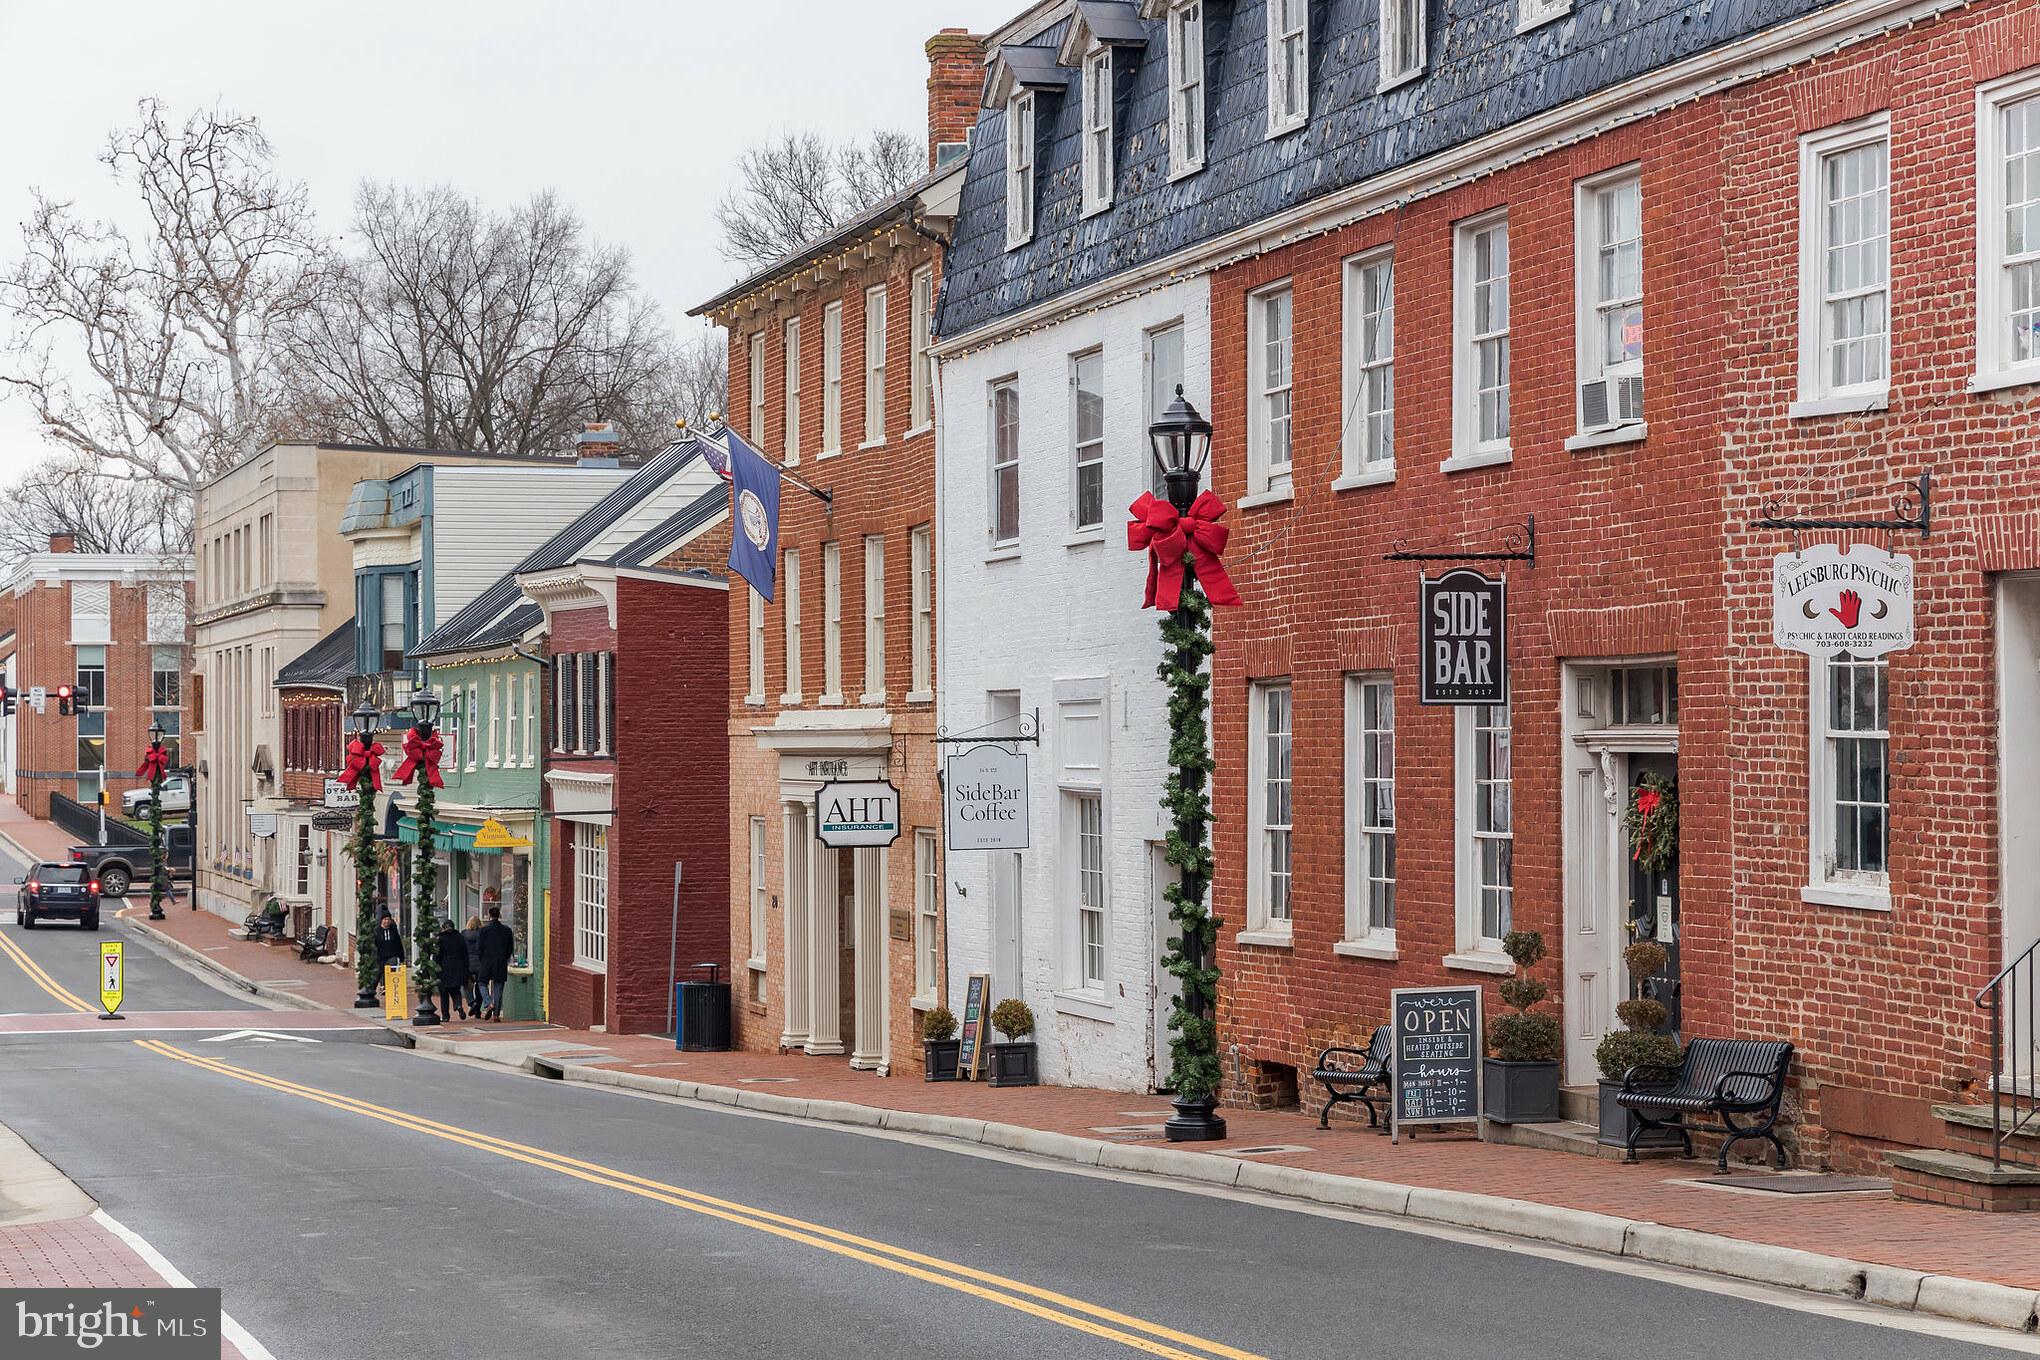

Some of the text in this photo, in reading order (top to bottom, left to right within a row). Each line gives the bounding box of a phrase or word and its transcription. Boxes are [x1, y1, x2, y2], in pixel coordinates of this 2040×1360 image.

[1787, 563, 1902, 597] LEESBURG PSYCHIC
[1433, 591, 1492, 637] SIDE
[1787, 632, 1815, 641] PSYCHIC
[1825, 632, 1847, 641] TAROT
[1848, 632, 1867, 641] CARD
[1869, 632, 1904, 641] READINGS
[1816, 640, 1873, 648] 703-608-3232
[1433, 640, 1494, 685] BAR
[955, 782, 1021, 801] SideBar
[824, 797, 892, 823] AHT
[960, 801, 1017, 822] Coffee
[1400, 996, 1471, 1008] we're
[1404, 1008, 1471, 1033] OPEN
[1418, 1036, 1445, 1044] INSIDE
[1420, 1049, 1454, 1058] SEATING
[1403, 1064, 1472, 1077] hours
